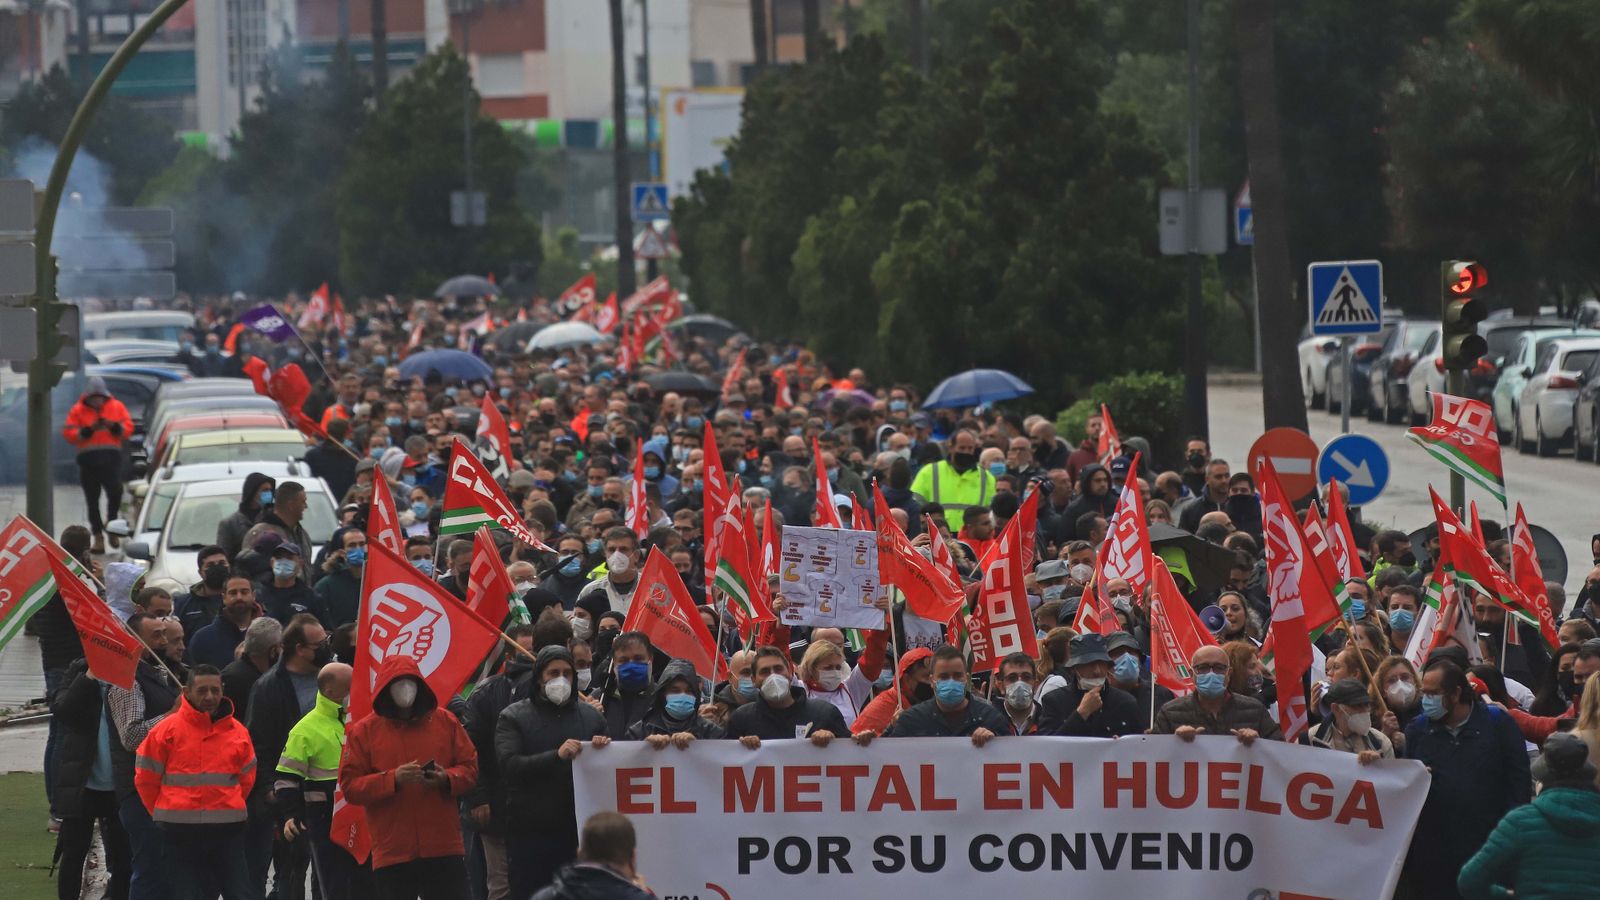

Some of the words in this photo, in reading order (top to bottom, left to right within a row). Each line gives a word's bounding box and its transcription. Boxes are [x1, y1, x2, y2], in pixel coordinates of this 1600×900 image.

[968, 603, 988, 663] Cádiz
[615, 767, 697, 814] EL
[724, 765, 956, 812] METAL
[984, 763, 1073, 809] EN
[1103, 761, 1385, 829] HUELGA
[737, 836, 854, 875] POR
[871, 834, 946, 873] SU
[968, 832, 1254, 872] CONVENIO
